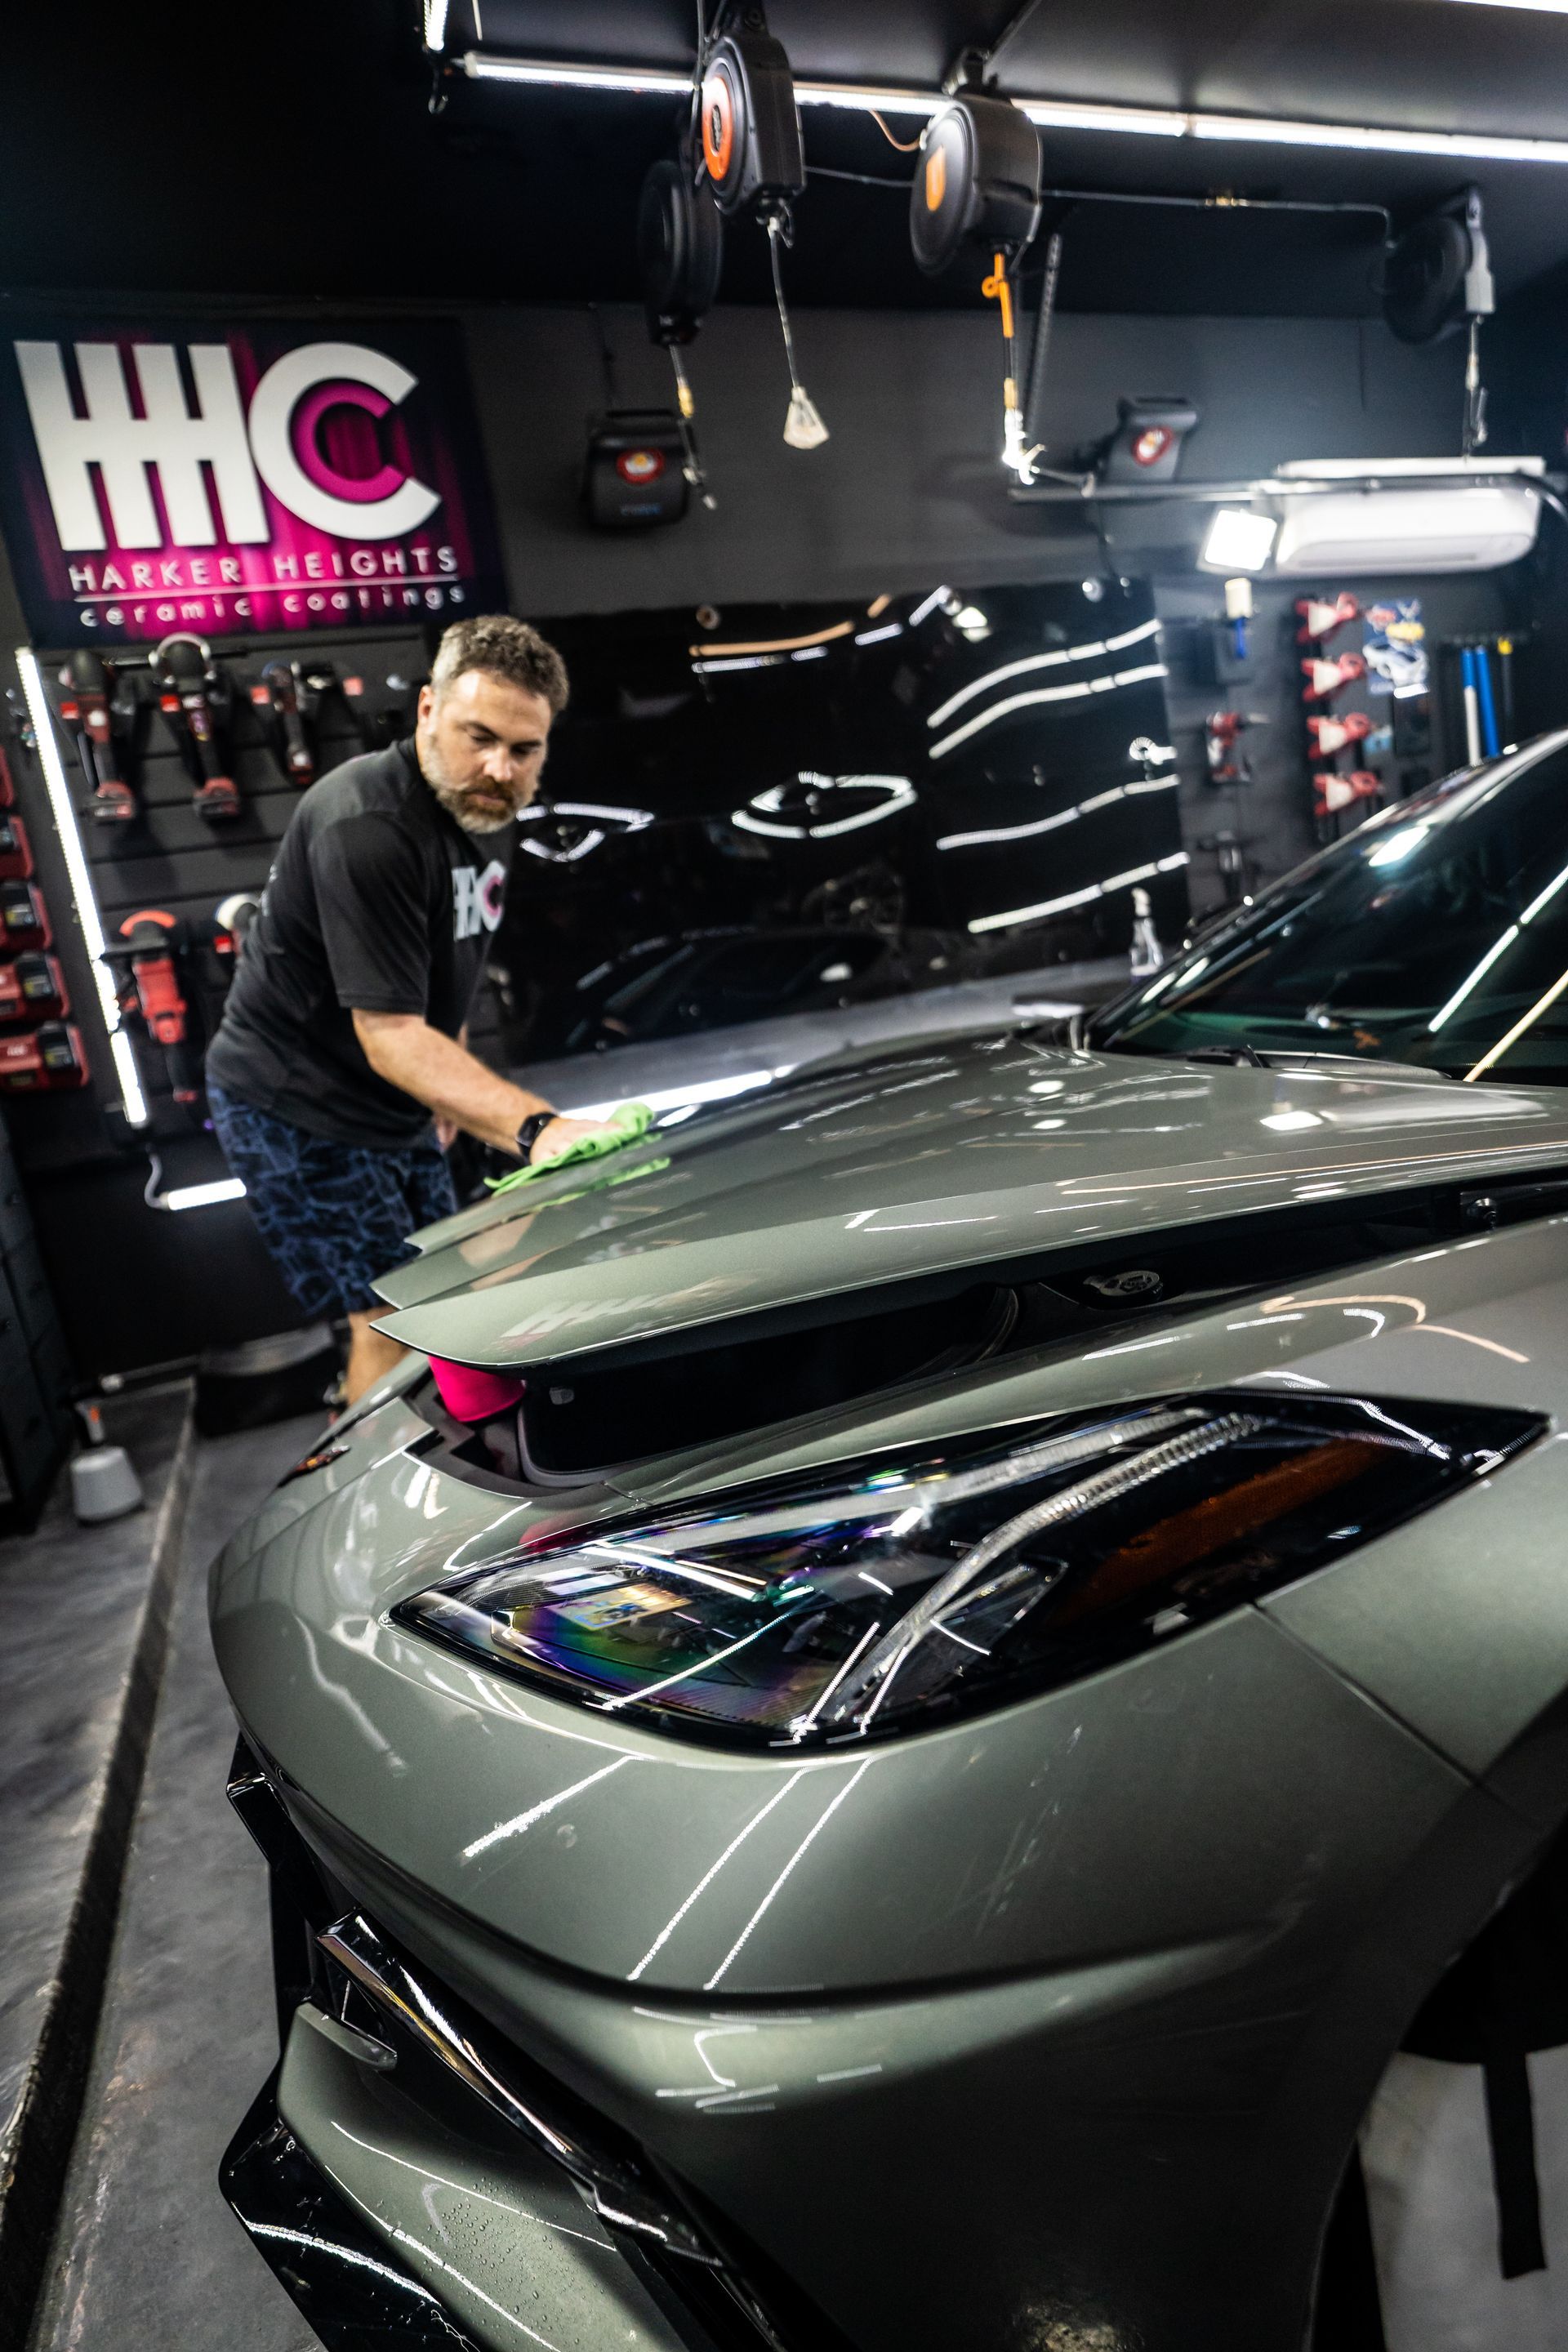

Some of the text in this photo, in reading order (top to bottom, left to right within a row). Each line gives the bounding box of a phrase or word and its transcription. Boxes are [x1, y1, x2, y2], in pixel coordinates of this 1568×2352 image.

[69, 546, 458, 592] HARKER HEIGHTS
[80, 586, 465, 627] ceramic coatings
